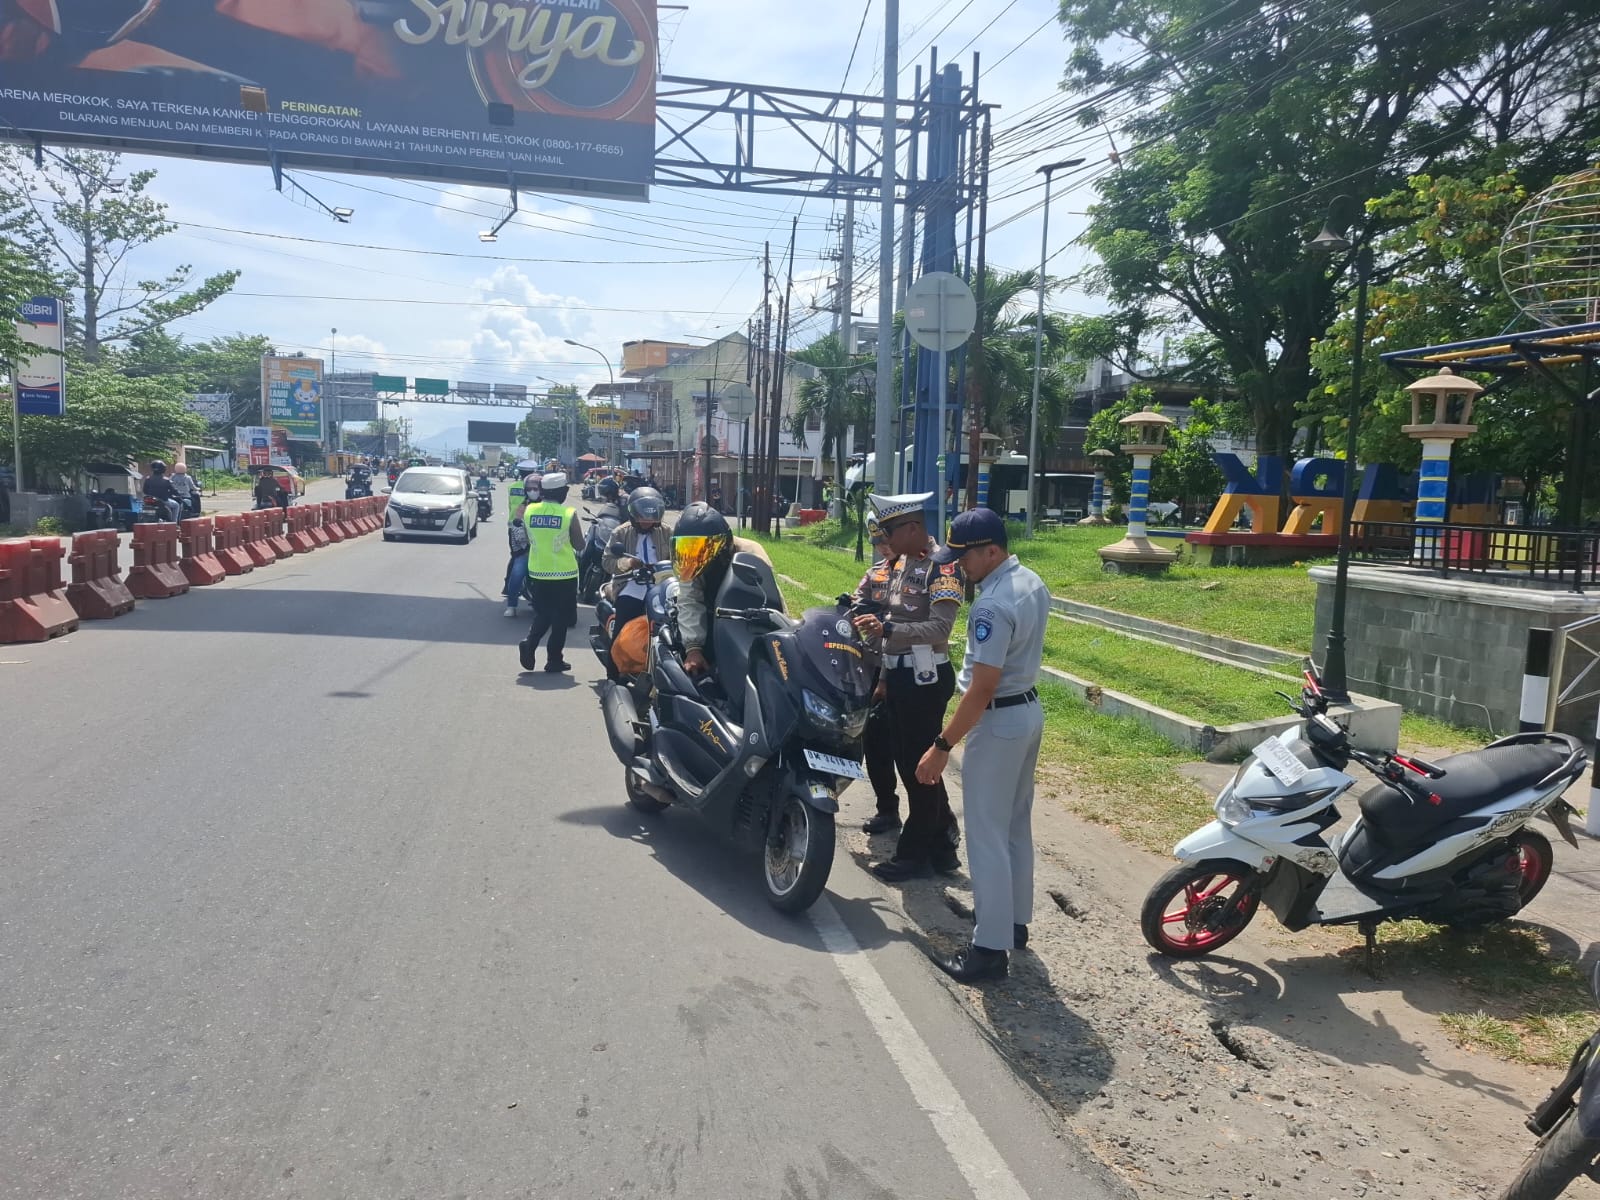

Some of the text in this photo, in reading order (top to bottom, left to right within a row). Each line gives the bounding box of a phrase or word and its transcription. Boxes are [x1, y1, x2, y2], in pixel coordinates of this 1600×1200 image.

[393, 0, 645, 89] Surya
[281, 101, 363, 117] PERINGATAN:
[59, 111, 118, 125] DILARANG
[121, 117, 173, 130] MENJUAL
[175, 121, 199, 132] DAN
[201, 124, 252, 137] MEMBERI
[255, 129, 298, 141] KPADA
[300, 132, 339, 144] ORANG
[341, 135, 352, 145] DI
[354, 137, 392, 149] BAWAH
[394, 141, 406, 150] 21
[409, 142, 443, 153] TAHUN
[445, 145, 467, 156] DAN
[534, 154, 565, 165] HAMIL
[117, 98, 149, 111] SAYA
[151, 101, 210, 116] TERKENA
[366, 121, 419, 135] LAYANAN
[422, 127, 480, 141] BERHENTI
[543, 138, 625, 157] (0800-177-6565)
[34, 305, 52, 315] BRI
[531, 516, 561, 528] POLISI
